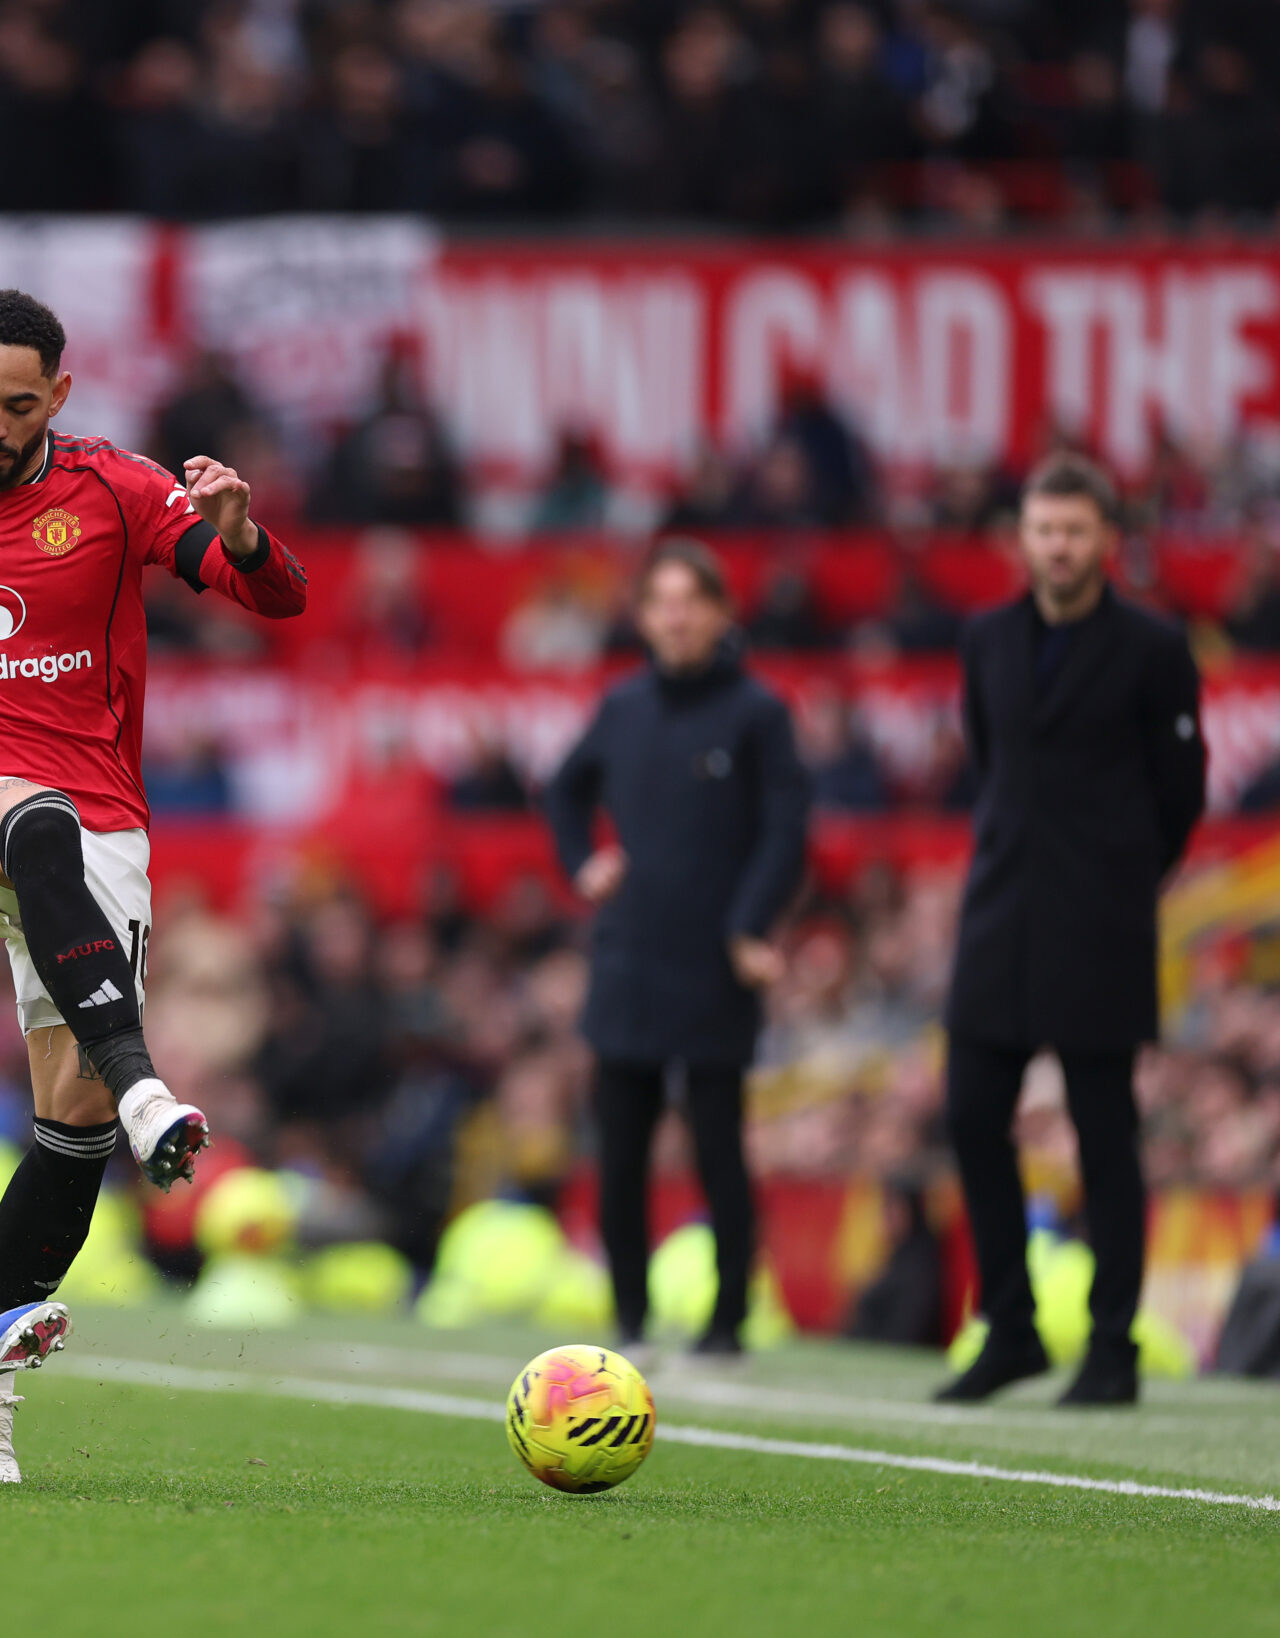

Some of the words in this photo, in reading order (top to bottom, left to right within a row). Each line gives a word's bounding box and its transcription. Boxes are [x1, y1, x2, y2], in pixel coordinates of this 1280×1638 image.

[36, 511, 77, 528] MANCHESTER
[43, 543, 71, 553] UNITED
[56, 939, 116, 965] MUFC
